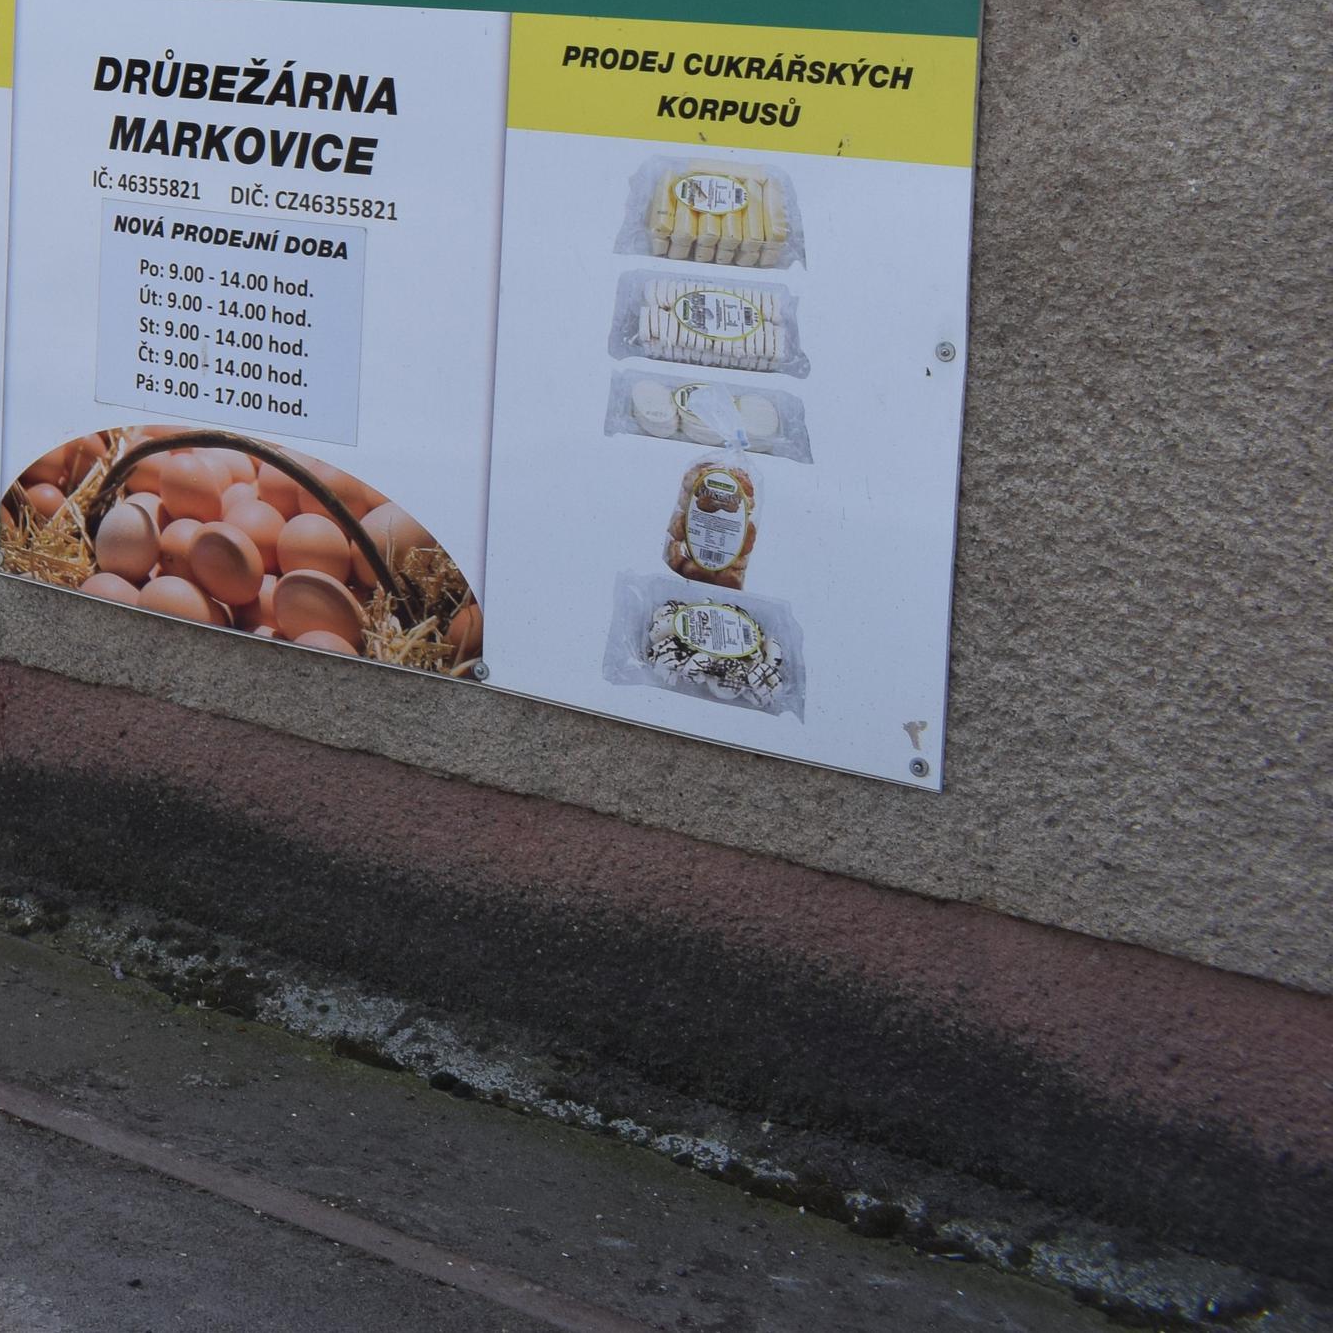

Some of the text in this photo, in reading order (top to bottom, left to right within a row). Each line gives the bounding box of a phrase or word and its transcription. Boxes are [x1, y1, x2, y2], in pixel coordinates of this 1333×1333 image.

[93, 49, 398, 116] DRŮBEŽÁRNA
[562, 45, 913, 90] PRODEJ CUKRÁŘSKÝCH
[657, 95, 801, 127] KORPUSŮ
[109, 116, 378, 176] MARKOVICE
[92, 167, 398, 221] IČ: 46355821 DIČ: CZ46355821
[113, 214, 348, 260] NOVÁ PRODEJNÍ DOBA
[140, 258, 164, 278] Po:
[168, 263, 204, 283] 9.00
[220, 270, 268, 292] 14.00
[273, 275, 314, 298] hod.
[139, 284, 162, 307] Út:
[167, 292, 203, 313] 9.00
[218, 300, 266, 322] 14.00
[271, 305, 312, 328] hod.
[139, 317, 160, 336] St:
[164, 320, 199, 341] 9.00
[215, 329, 263, 351] 14.00
[268, 334, 309, 357] hod.
[138, 341, 160, 364] Čt:
[164, 350, 199, 370] 9.00
[214, 358, 263, 380] 14.00
[267, 364, 308, 387] hod.
[136, 373, 159, 393] Pá:
[164, 378, 199, 399] 9.00
[214, 387, 263, 410] 17.00
[267, 393, 308, 417] hod.
